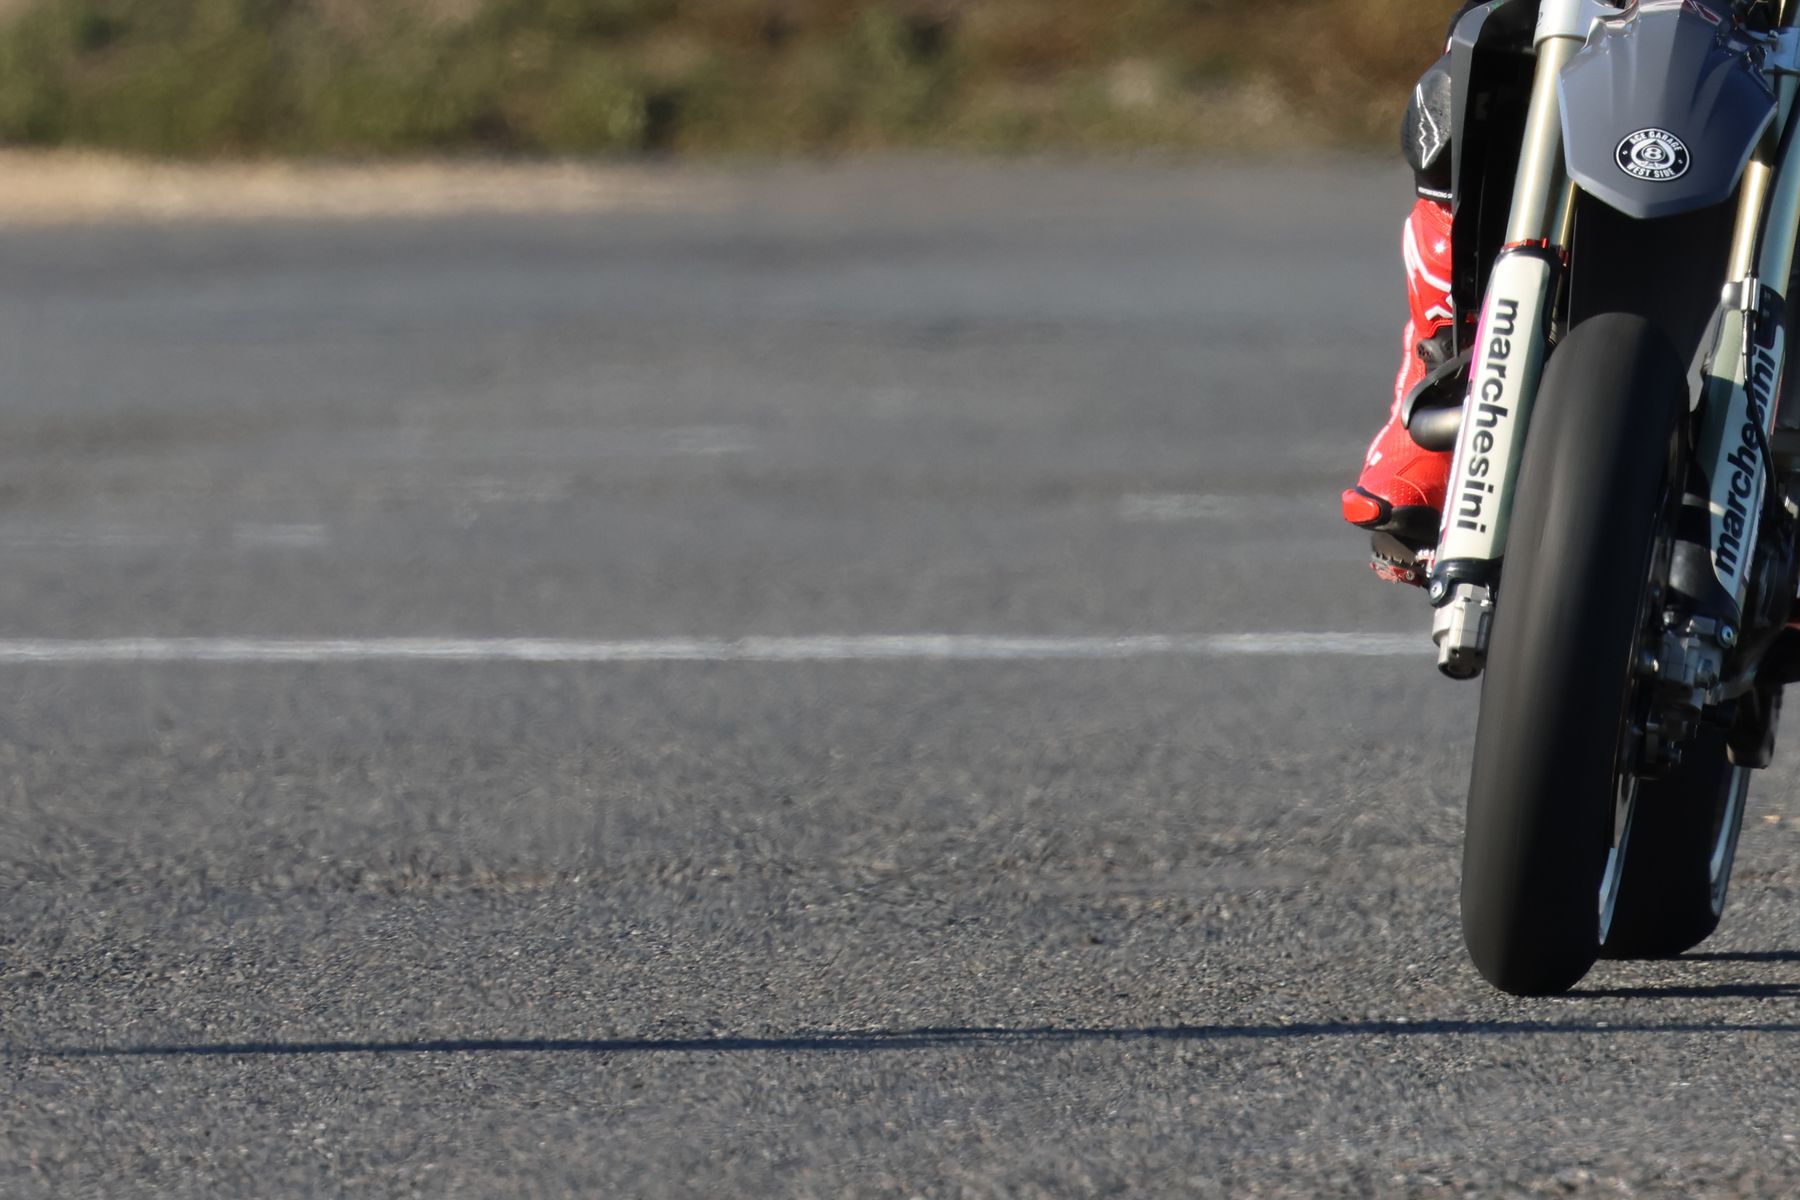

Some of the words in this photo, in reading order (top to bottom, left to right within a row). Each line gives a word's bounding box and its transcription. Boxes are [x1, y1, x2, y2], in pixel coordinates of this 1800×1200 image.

[1629, 132, 1647, 144] ACE
[1648, 130, 1683, 151] GARAGE
[1626, 161, 1651, 177] WEST
[1653, 167, 1676, 178] SIDE
[1455, 298, 1520, 534] marchesini
